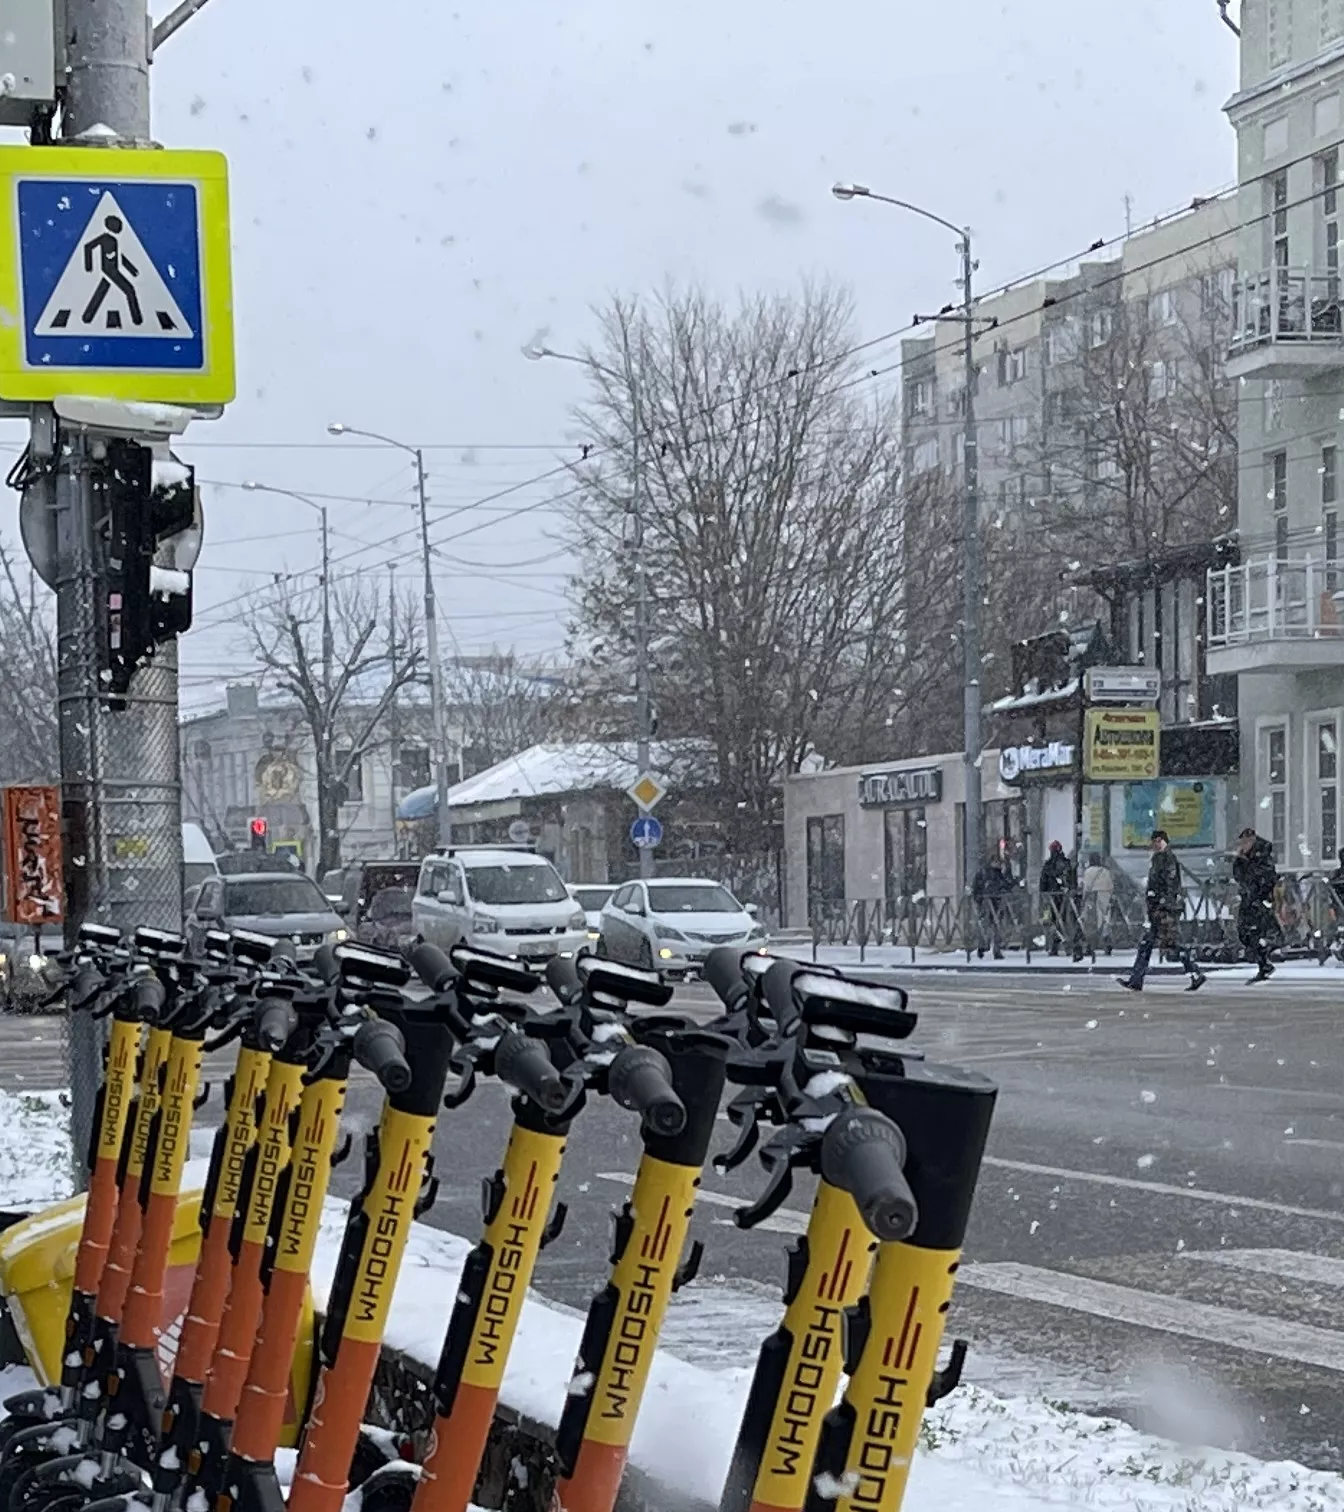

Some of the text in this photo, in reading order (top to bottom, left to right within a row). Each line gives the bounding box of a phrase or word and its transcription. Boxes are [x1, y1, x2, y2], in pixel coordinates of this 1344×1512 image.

[104, 1069, 125, 1146] WHOOSH
[157, 1094, 183, 1182] WHOOSH
[221, 1110, 251, 1203] WHOOSH
[251, 1127, 283, 1226] WHOOSH
[281, 1147, 320, 1255] WHOOSH
[356, 1197, 405, 1321] WHOOSH
[474, 1223, 528, 1365] WHOOSH
[601, 1264, 660, 1419] WHOOSH
[771, 1305, 839, 1475] WHOOSH
